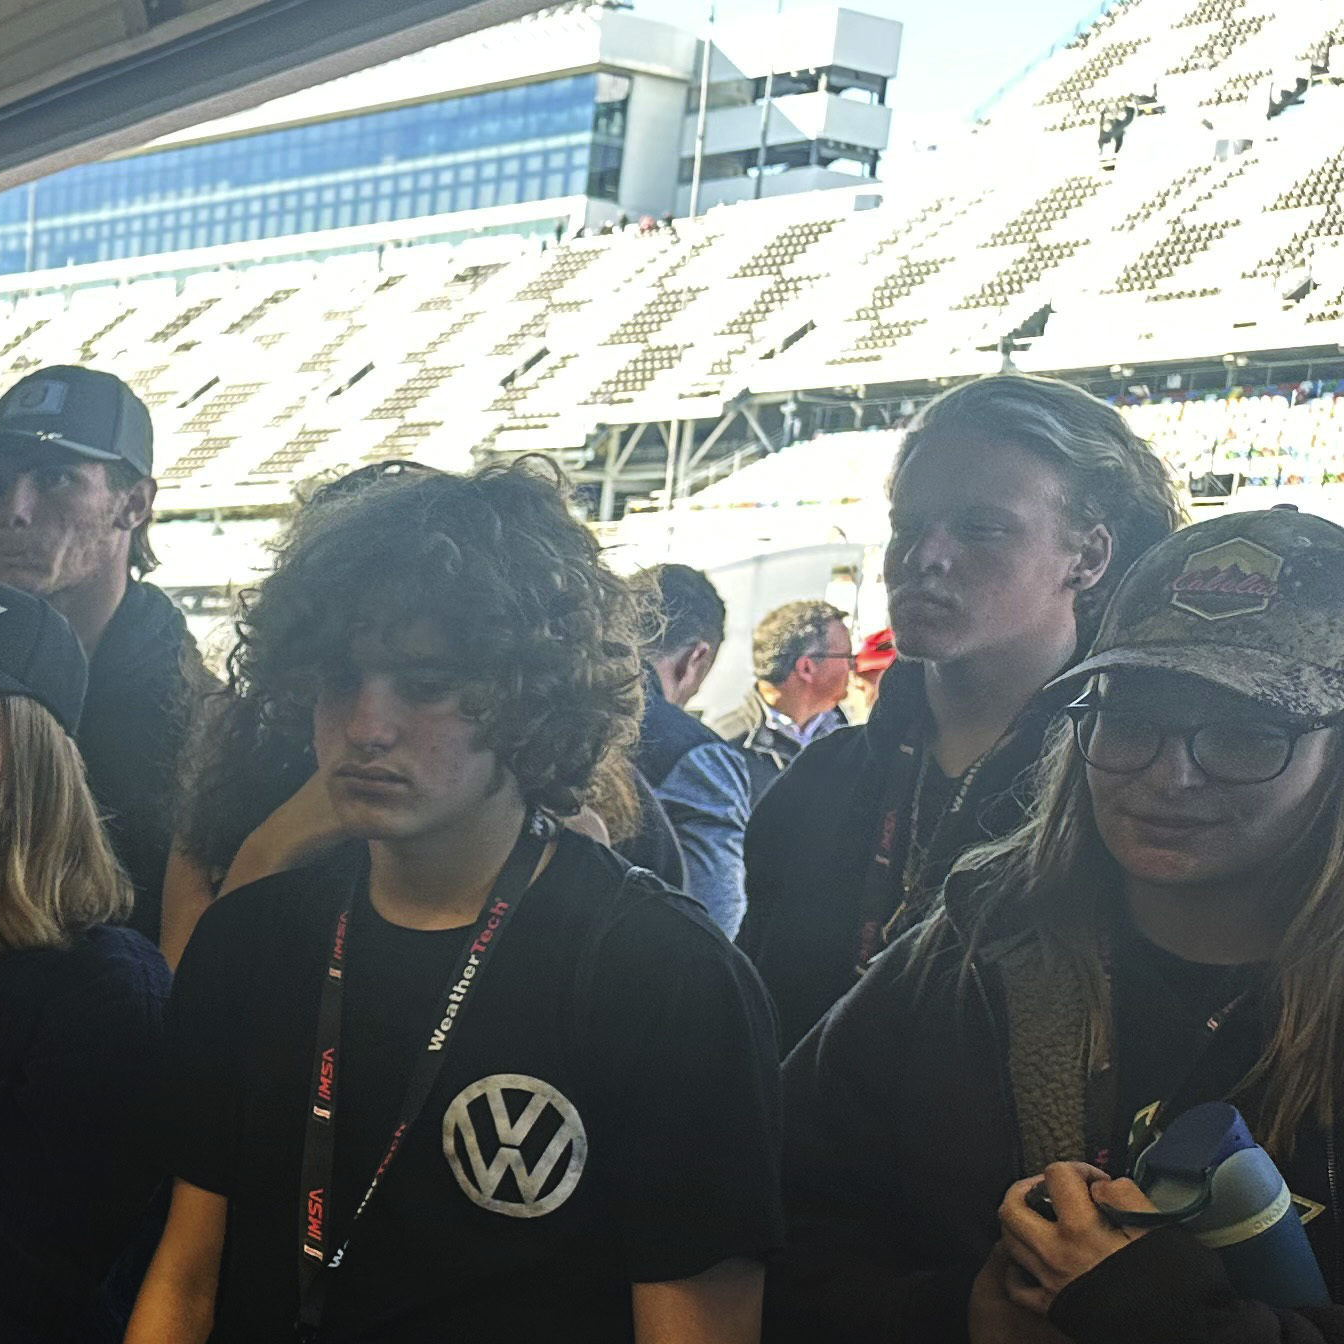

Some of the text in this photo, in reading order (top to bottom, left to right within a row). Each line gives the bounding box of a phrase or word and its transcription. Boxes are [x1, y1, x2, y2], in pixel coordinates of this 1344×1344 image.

[333, 911, 349, 960] IMSA
[427, 896, 511, 1053] WeatherTech
[317, 1047, 335, 1101] IMSA
[307, 1187, 324, 1241] IMSA
